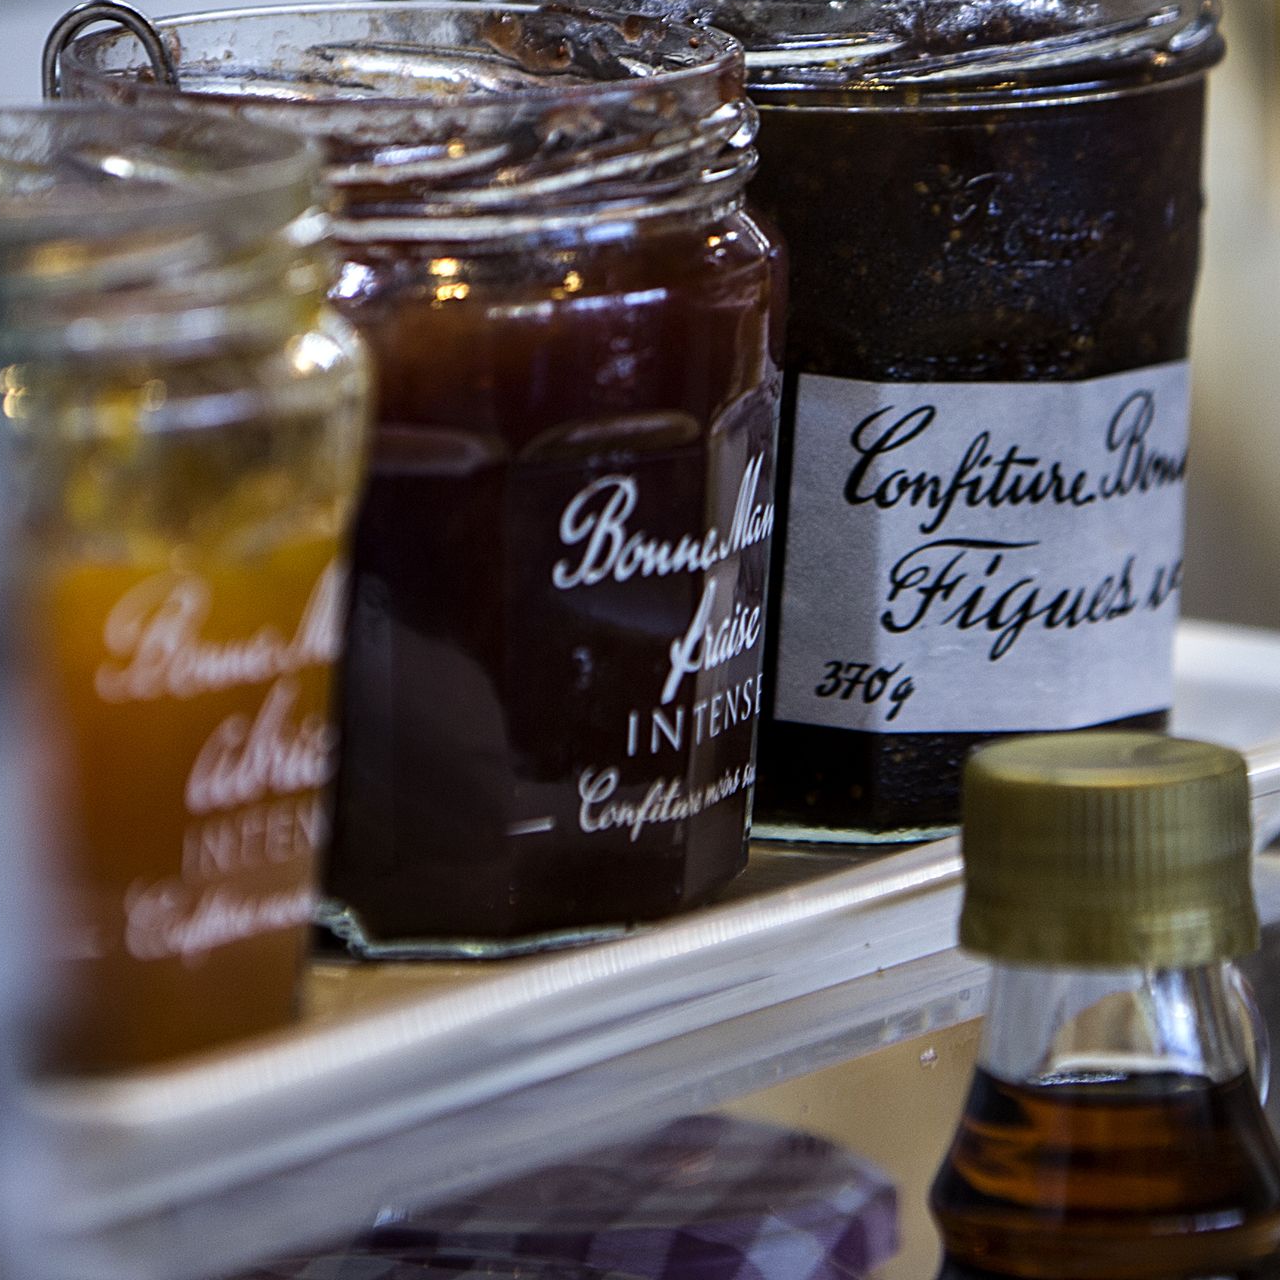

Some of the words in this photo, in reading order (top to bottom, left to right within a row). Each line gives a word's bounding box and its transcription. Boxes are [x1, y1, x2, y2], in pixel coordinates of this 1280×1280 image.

[842, 404, 1098, 535] Confiture
[553, 474, 718, 590] Bonne
[661, 577, 762, 705] fraise
[879, 537, 1136, 661] Figues
[578, 766, 701, 843] Confiture
